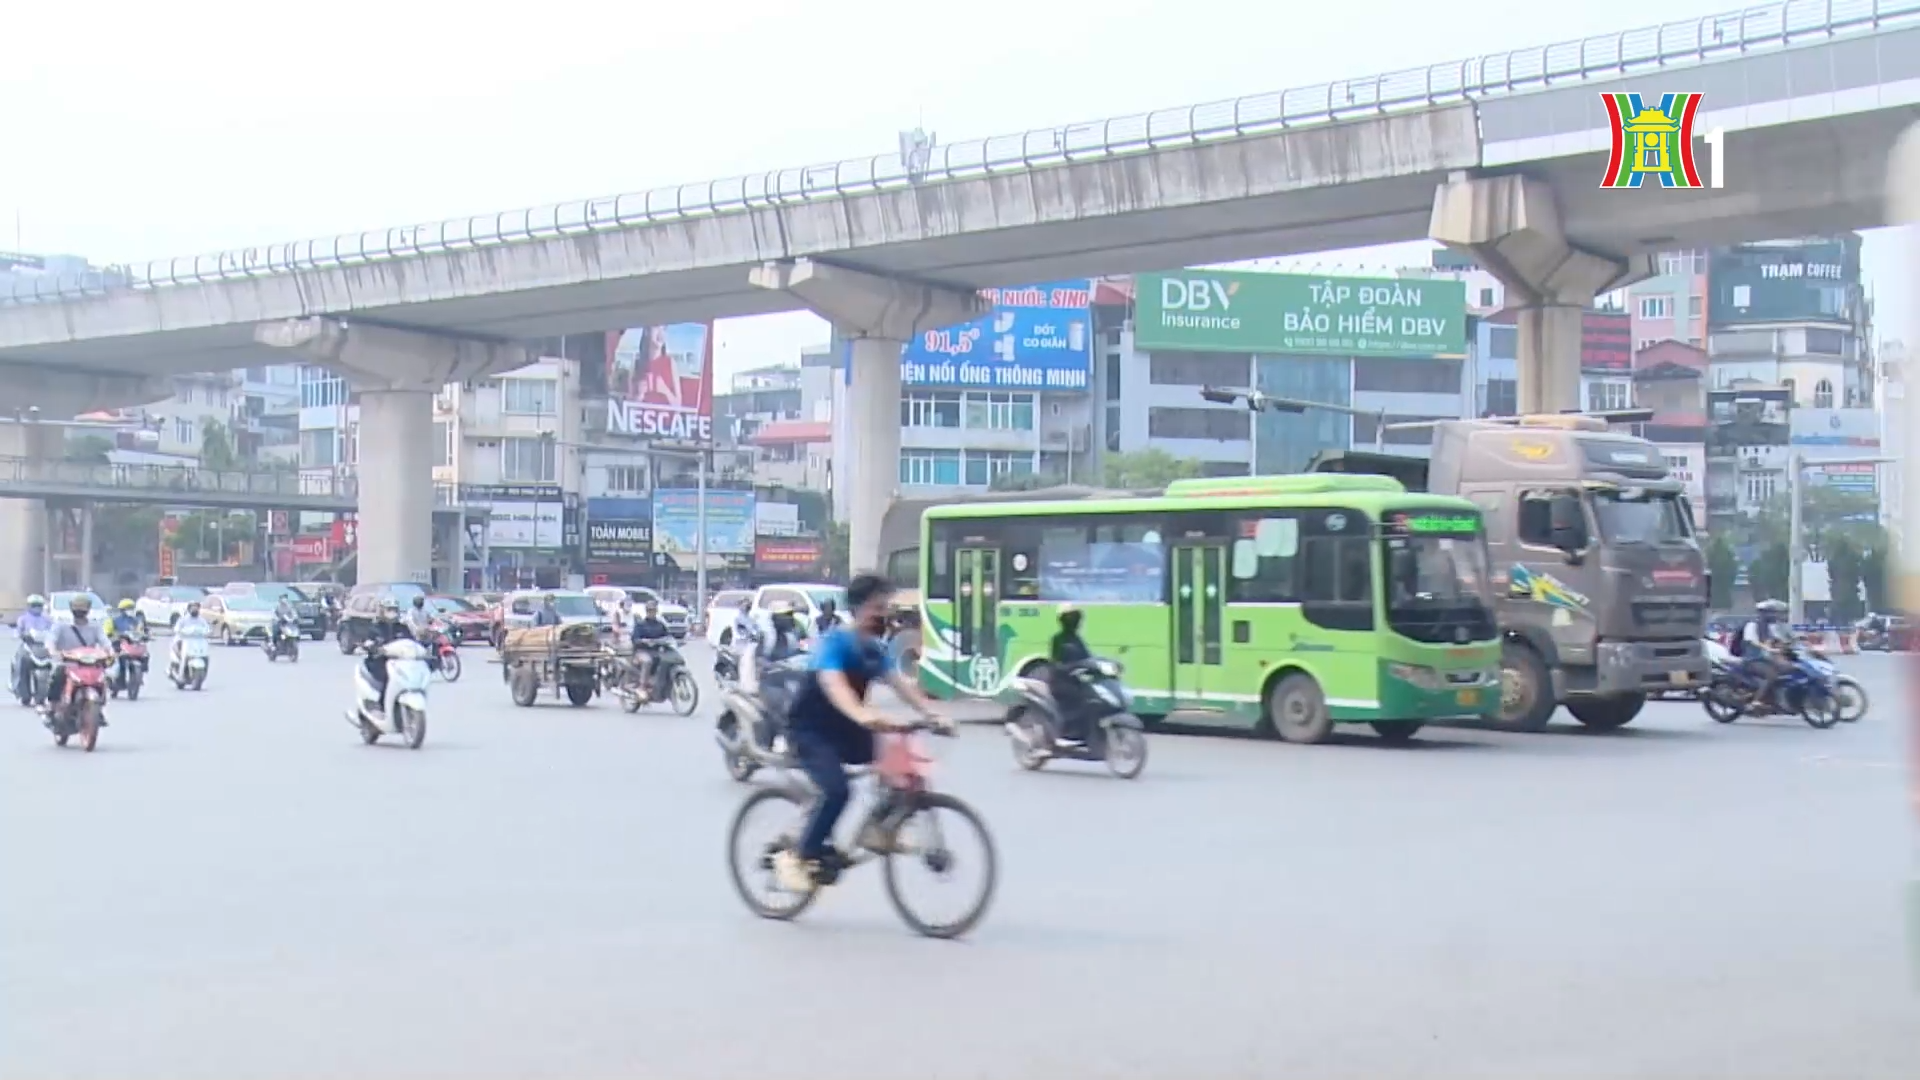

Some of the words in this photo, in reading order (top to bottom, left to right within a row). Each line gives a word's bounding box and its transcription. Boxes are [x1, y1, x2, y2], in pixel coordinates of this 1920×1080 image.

[1807, 262, 1842, 278] COFFEE
[1051, 288, 1089, 308] SINO
[1162, 277, 1240, 311] DBV
[1309, 279, 1350, 309] TẬP
[1358, 282, 1421, 307] ĐOÀN
[1162, 310, 1241, 329] Insurance
[1283, 306, 1330, 332] BẢO
[1338, 306, 1393, 335] HIỂM
[1401, 317, 1446, 336] DBV
[929, 358, 955, 383] NỐI
[959, 359, 990, 384] ỐNG
[994, 363, 1043, 386] THÔNG
[1046, 368, 1086, 387] MINH
[617, 526, 650, 540] MOBILE
